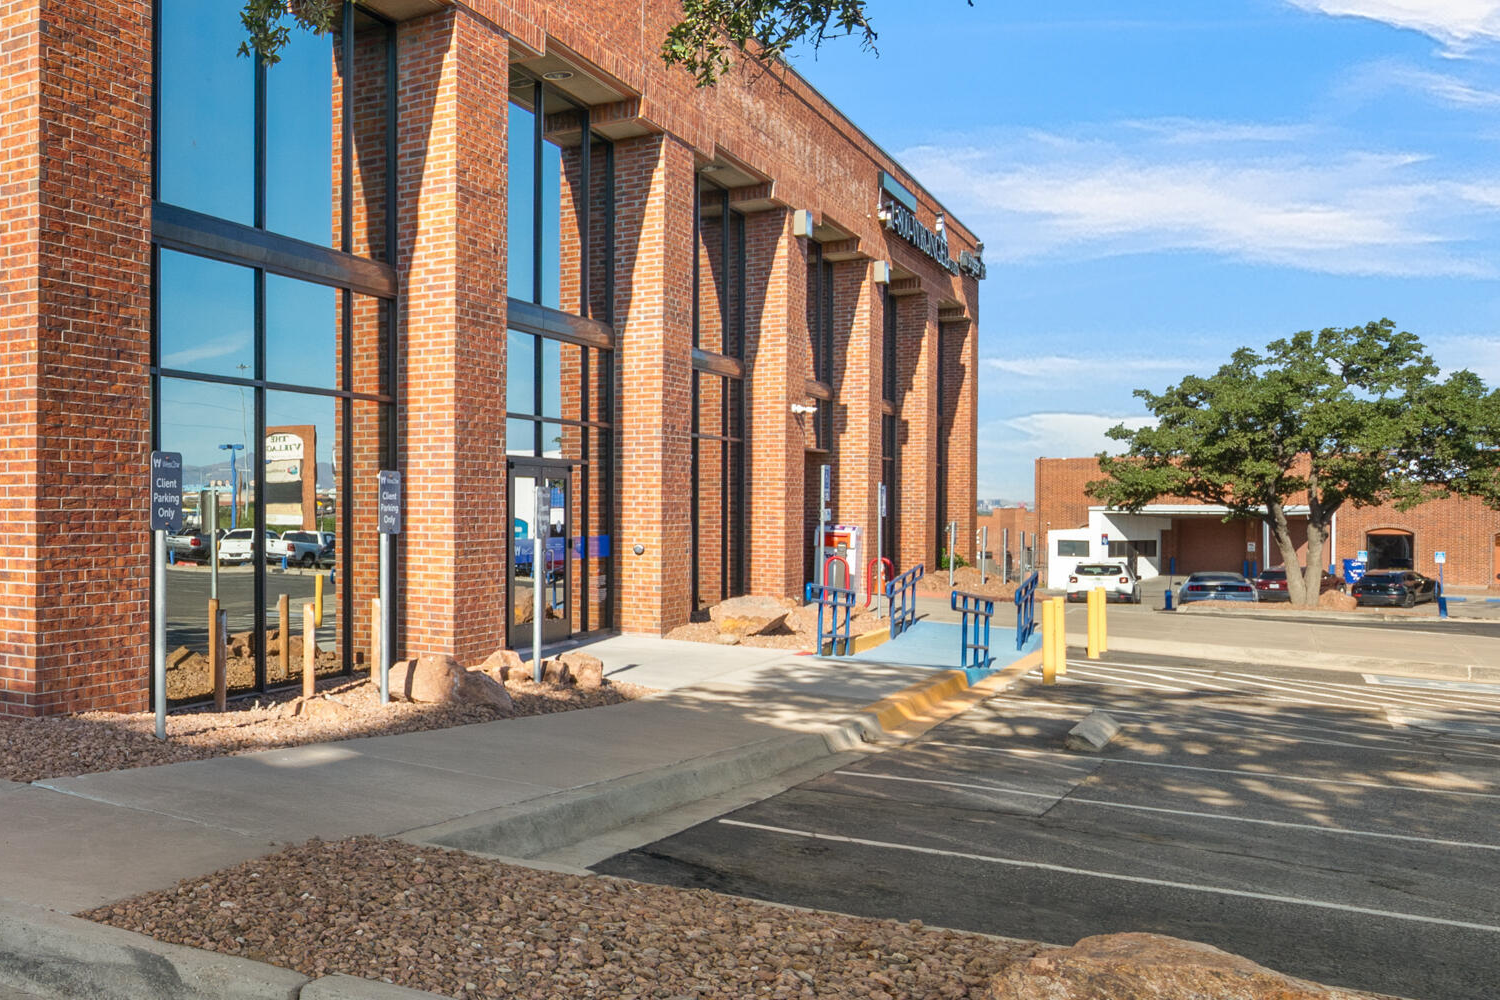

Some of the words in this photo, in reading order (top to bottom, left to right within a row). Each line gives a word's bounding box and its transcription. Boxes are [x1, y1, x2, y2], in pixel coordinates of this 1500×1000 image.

[156, 477, 177, 489] Client
[153, 492, 180, 505] Parking
[382, 491, 397, 500] Client
[157, 507, 175, 520] Only
[380, 503, 399, 514] Parking
[383, 514, 396, 526] Only
